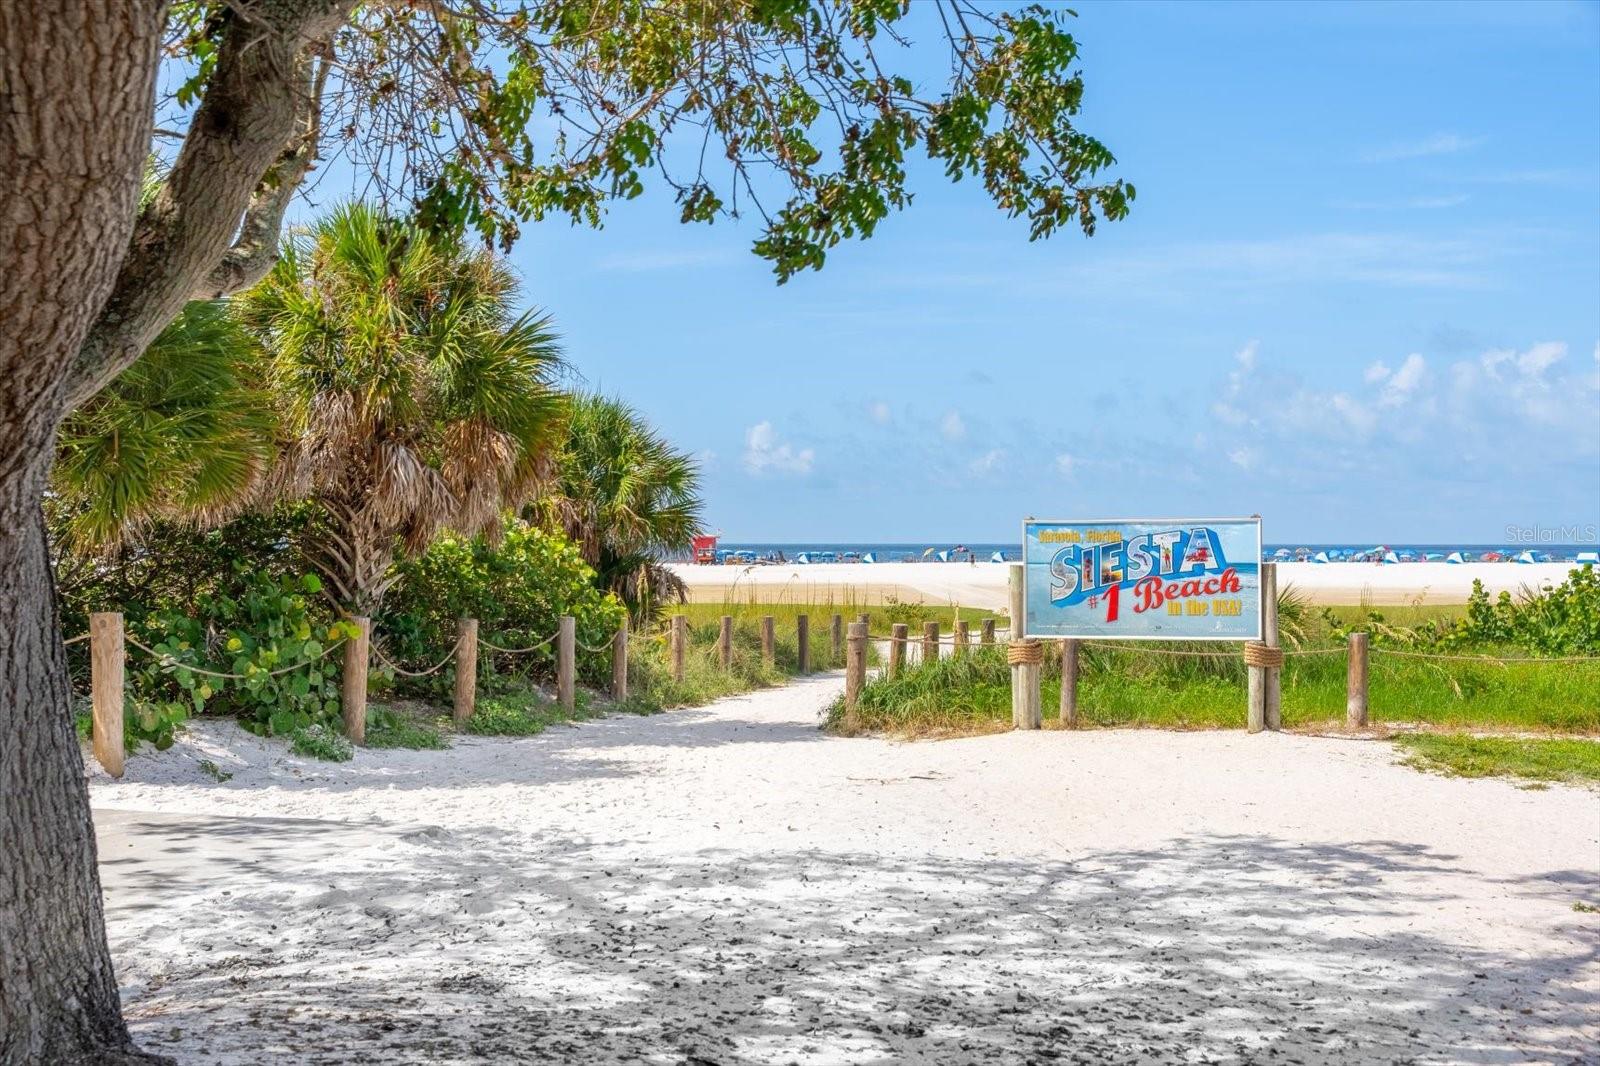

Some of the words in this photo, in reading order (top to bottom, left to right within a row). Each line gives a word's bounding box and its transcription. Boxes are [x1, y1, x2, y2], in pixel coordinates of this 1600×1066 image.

[1050, 528, 1222, 602] SIESTA
[1133, 567, 1242, 613] Beach
[1186, 600, 1209, 616] the
